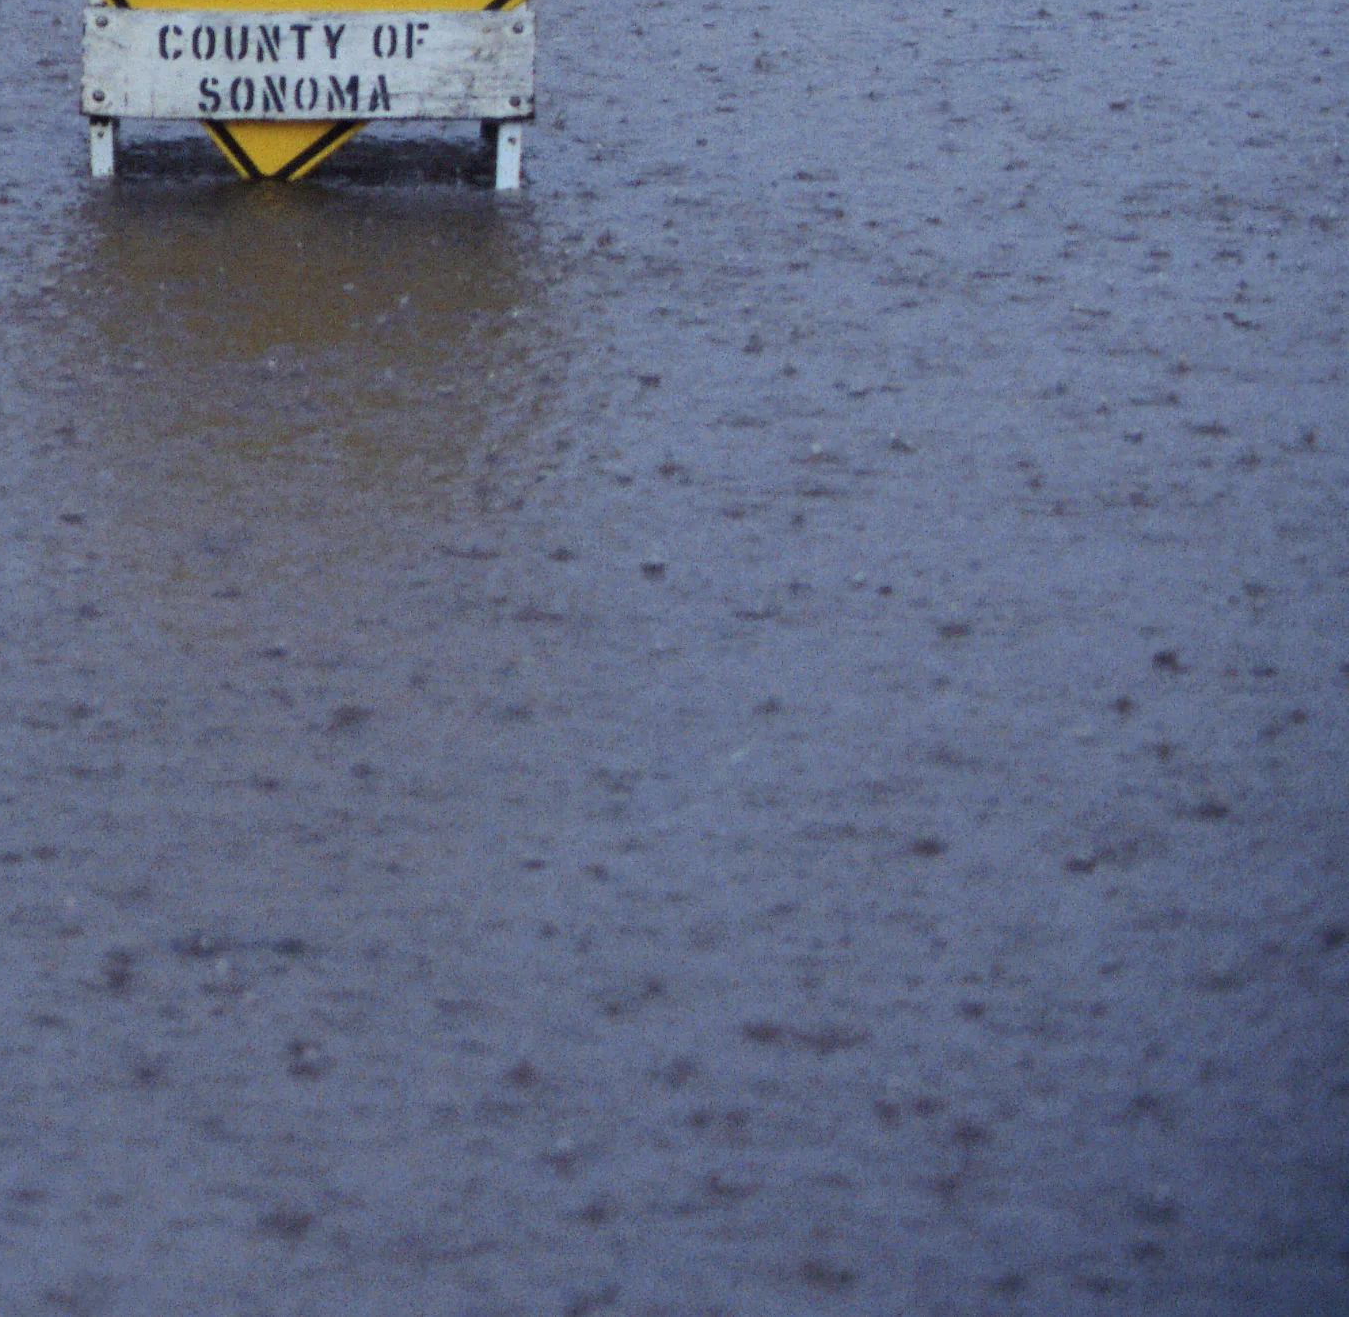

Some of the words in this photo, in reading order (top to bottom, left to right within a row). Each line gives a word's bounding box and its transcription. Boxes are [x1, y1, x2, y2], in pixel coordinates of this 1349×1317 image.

[158, 22, 347, 63] COUNTY
[372, 22, 431, 60] OF
[197, 74, 392, 114] SONOMA
